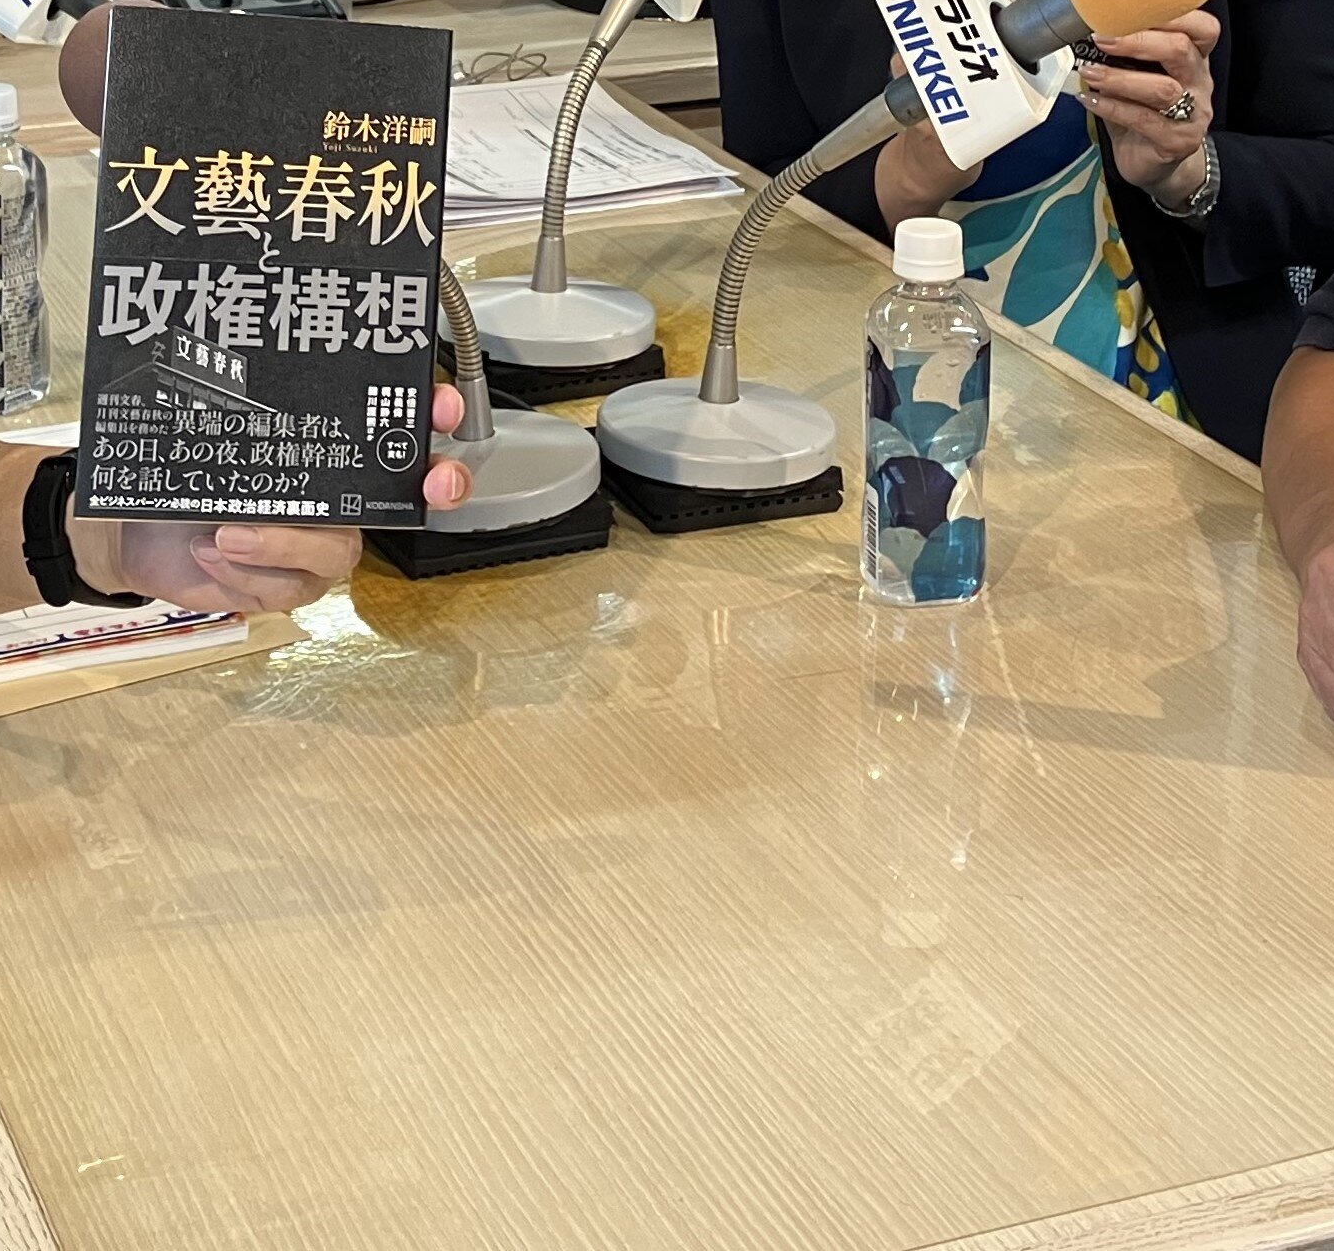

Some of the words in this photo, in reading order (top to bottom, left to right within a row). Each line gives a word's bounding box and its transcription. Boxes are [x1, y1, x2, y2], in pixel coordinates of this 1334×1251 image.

[886, 0, 969, 124] NIKKEI
[323, 111, 436, 146] 鈴木洋嗣
[322, 142, 342, 152] Yoji
[346, 143, 378, 154] Suzuki
[104, 146, 437, 247] 文藝春秋
[257, 232, 282, 274] と
[98, 261, 431, 354] 政権構想
[172, 409, 350, 440] 異端の編集者は、
[93, 436, 364, 468] あの日、あの夜、政権幹部と
[91, 464, 310, 495] 何を話していたのか?
[366, 501, 415, 511] KODANSHA
